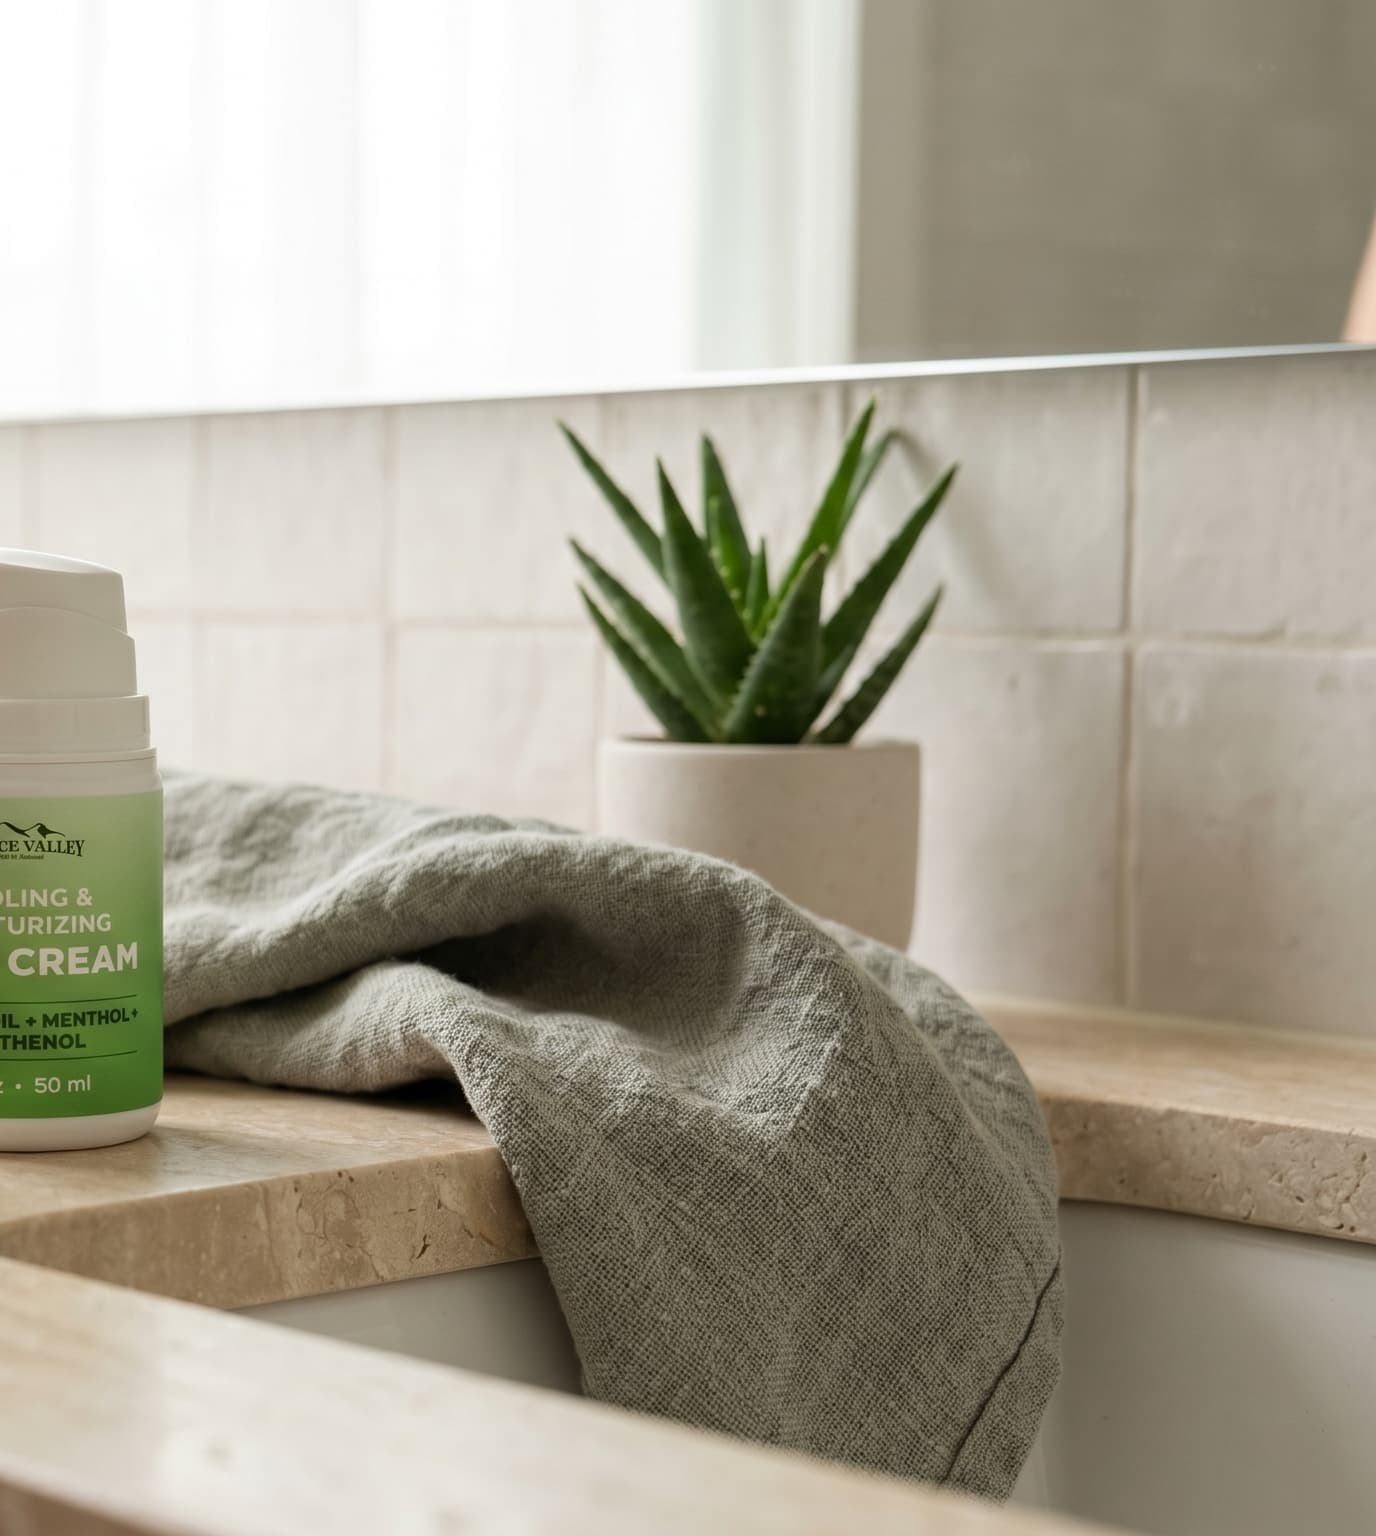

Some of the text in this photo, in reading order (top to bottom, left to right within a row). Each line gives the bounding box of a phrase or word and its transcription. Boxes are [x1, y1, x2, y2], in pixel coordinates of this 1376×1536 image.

[24, 839, 85, 857] VALLEY
[76, 887, 93, 906] &
[8, 942, 138, 976] CREAM
[25, 1016, 37, 1027] +
[34, 1076, 61, 1094] 50
[67, 1074, 92, 1093] ml
